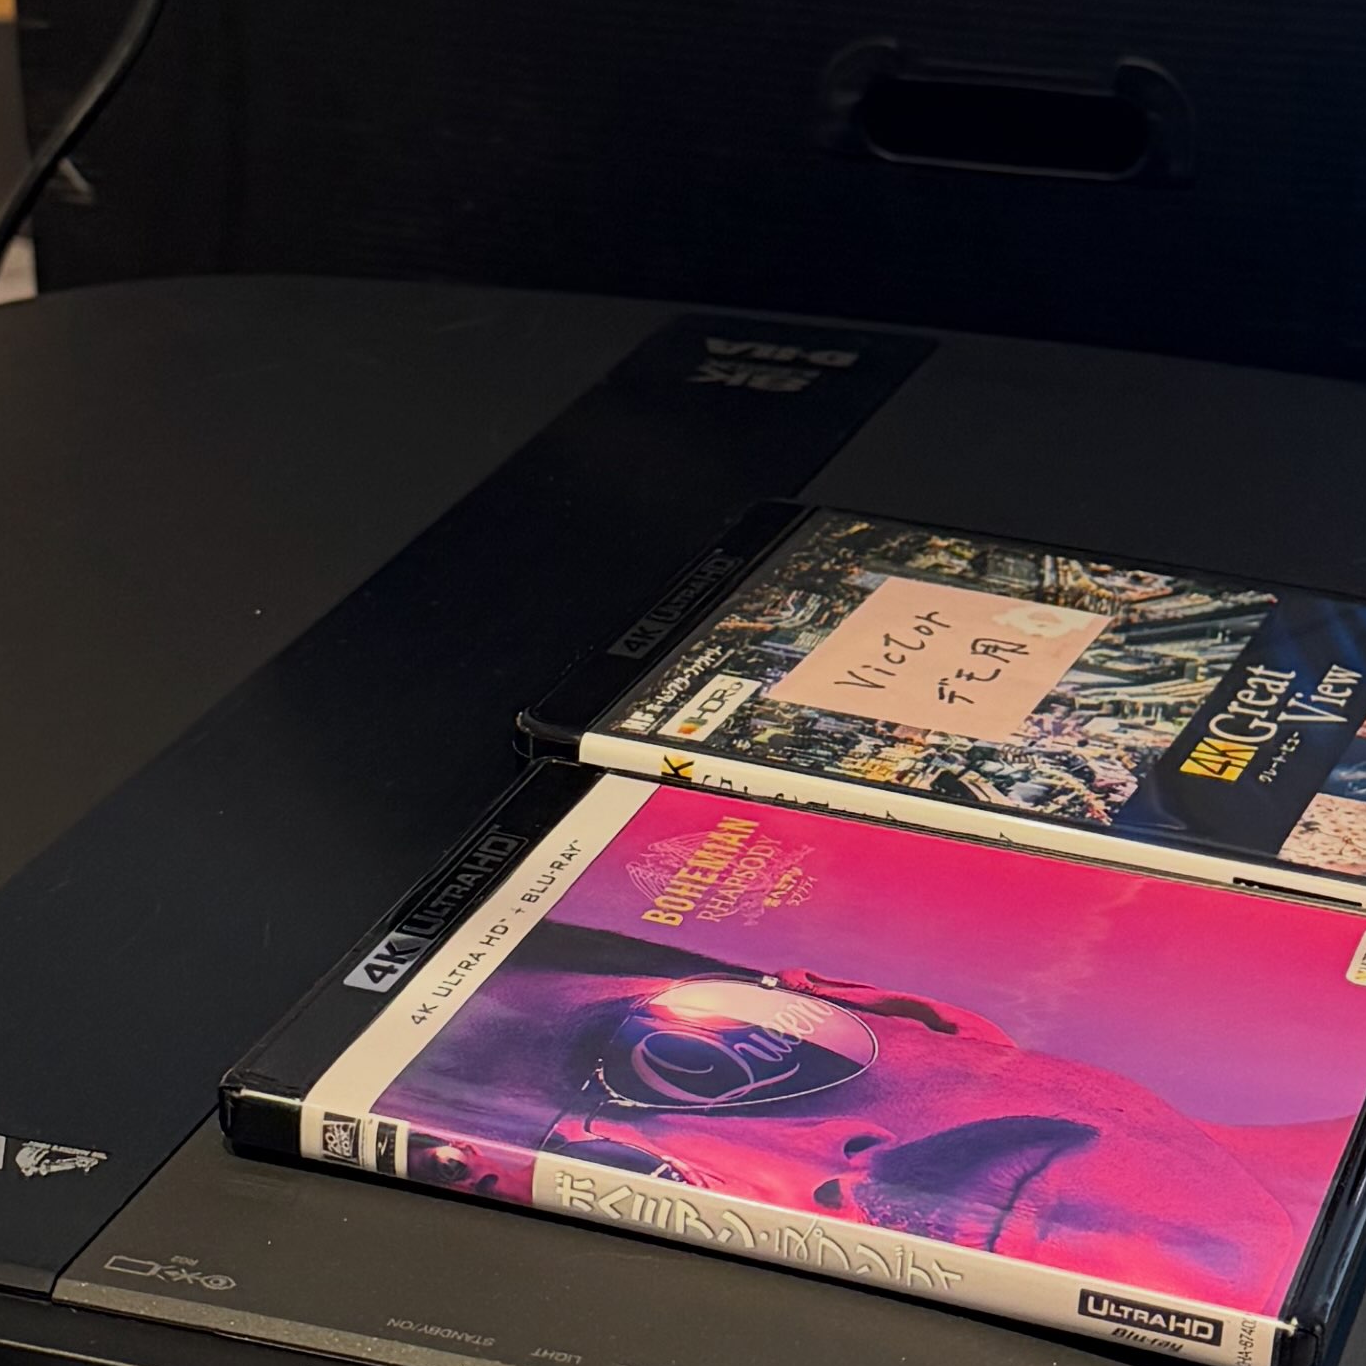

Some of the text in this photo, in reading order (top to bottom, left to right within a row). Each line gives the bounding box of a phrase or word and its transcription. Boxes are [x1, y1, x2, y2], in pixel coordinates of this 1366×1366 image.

[938, 638, 1030, 705] デモ用
[1209, 665, 1296, 742] Great
[1277, 664, 1362, 722] View
[641, 816, 759, 926] BOHEMIAN
[695, 835, 781, 923] RHAPSODY
[363, 941, 421, 984] 4K
[411, 1003, 438, 1025] 4K
[432, 951, 486, 998] ULTRA
[521, 841, 582, 903] BLU-RAY
[631, 998, 834, 1104] Queen
[387, 1317, 496, 1348] STANDBY/ON
[531, 1346, 582, 1365] LIGHT
[1111, 1327, 1185, 1353] Blu-ray
